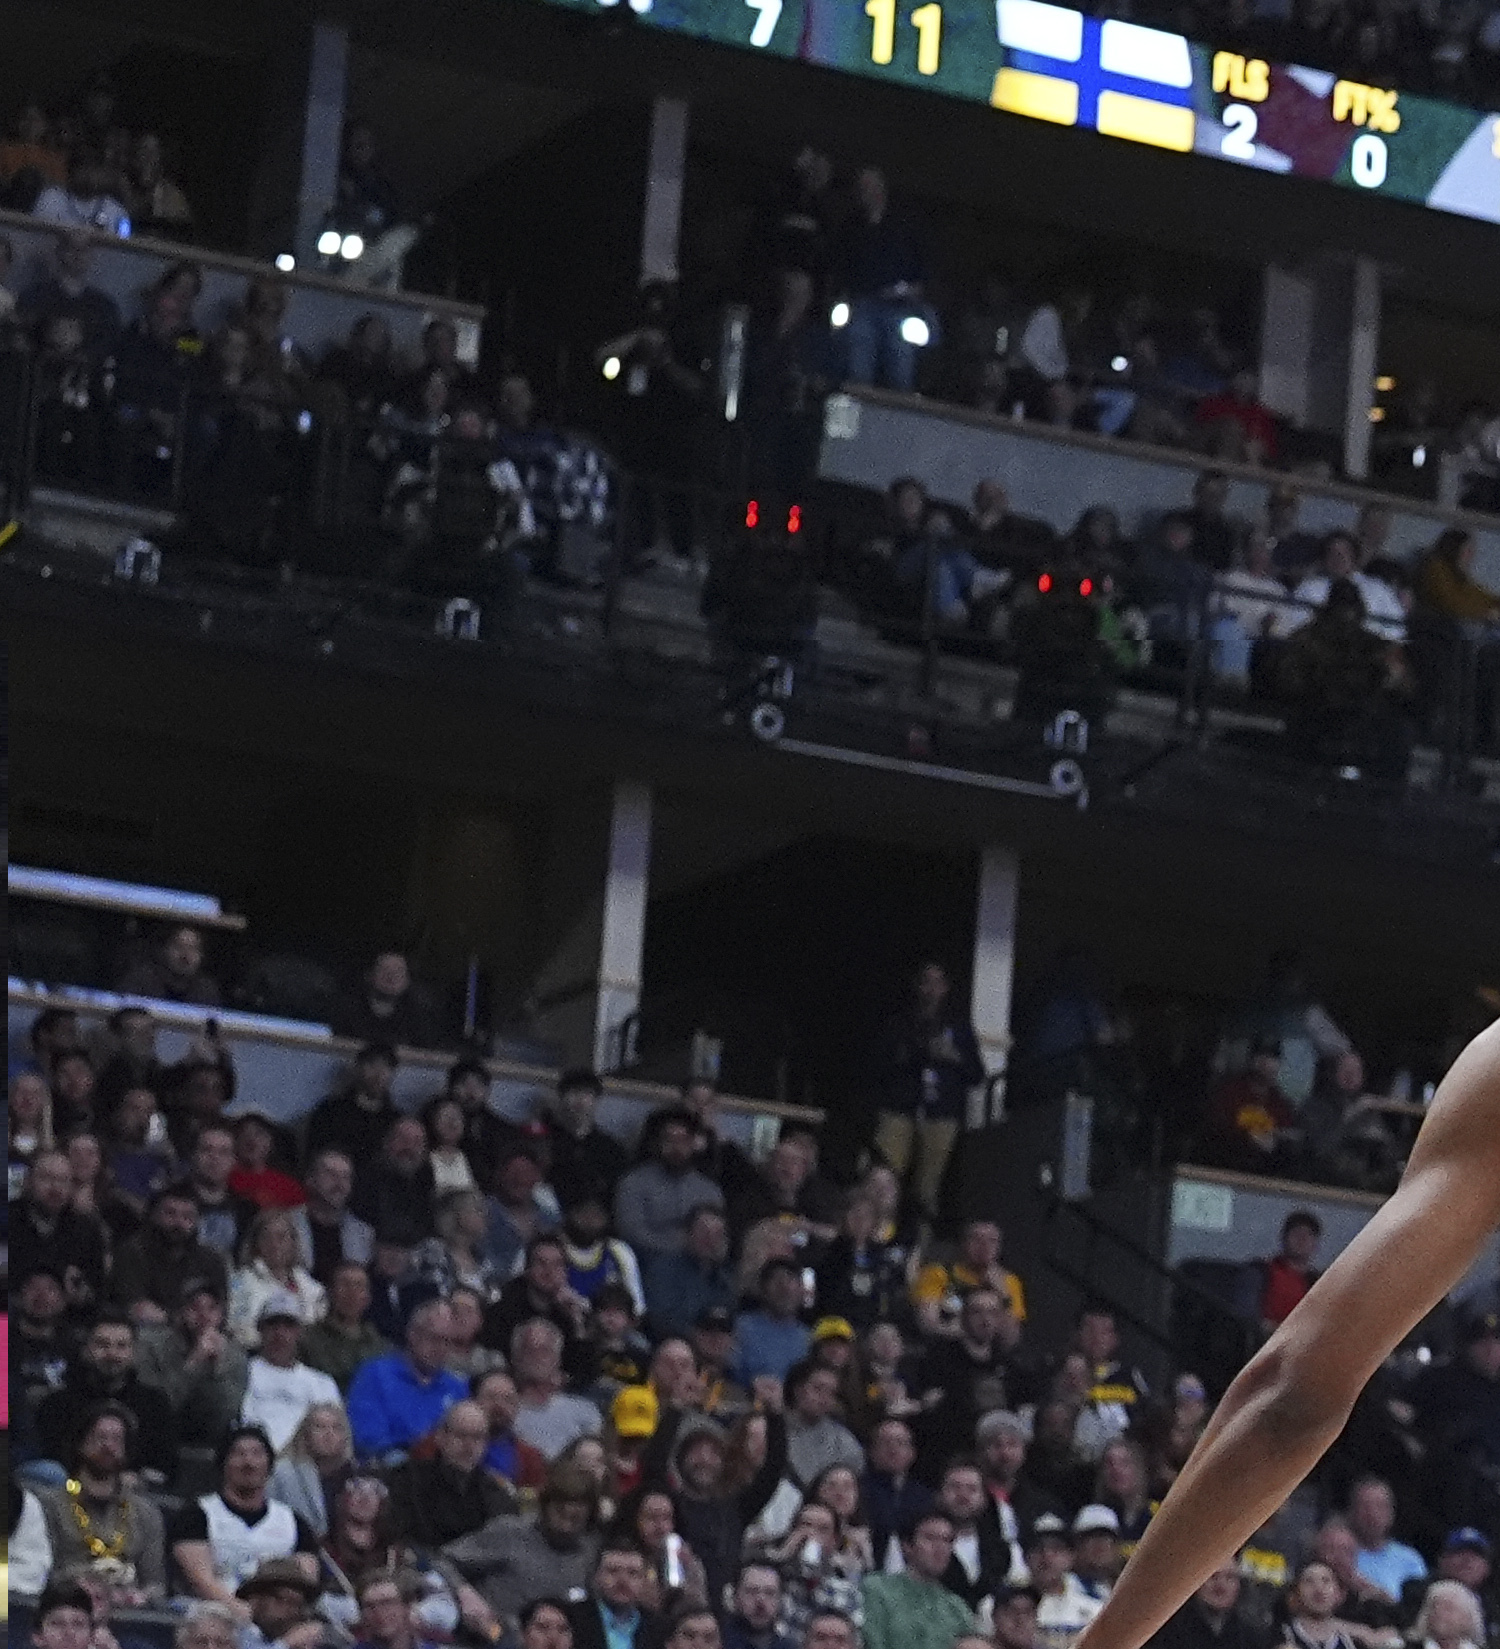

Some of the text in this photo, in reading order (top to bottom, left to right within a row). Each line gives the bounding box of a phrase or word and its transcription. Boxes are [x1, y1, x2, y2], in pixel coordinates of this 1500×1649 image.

[865, 0, 942, 75] 11
[1212, 51, 1270, 102] FLS
[1221, 103, 1258, 159] 2
[1333, 79, 1401, 134] FT%
[1351, 134, 1388, 188] 0
